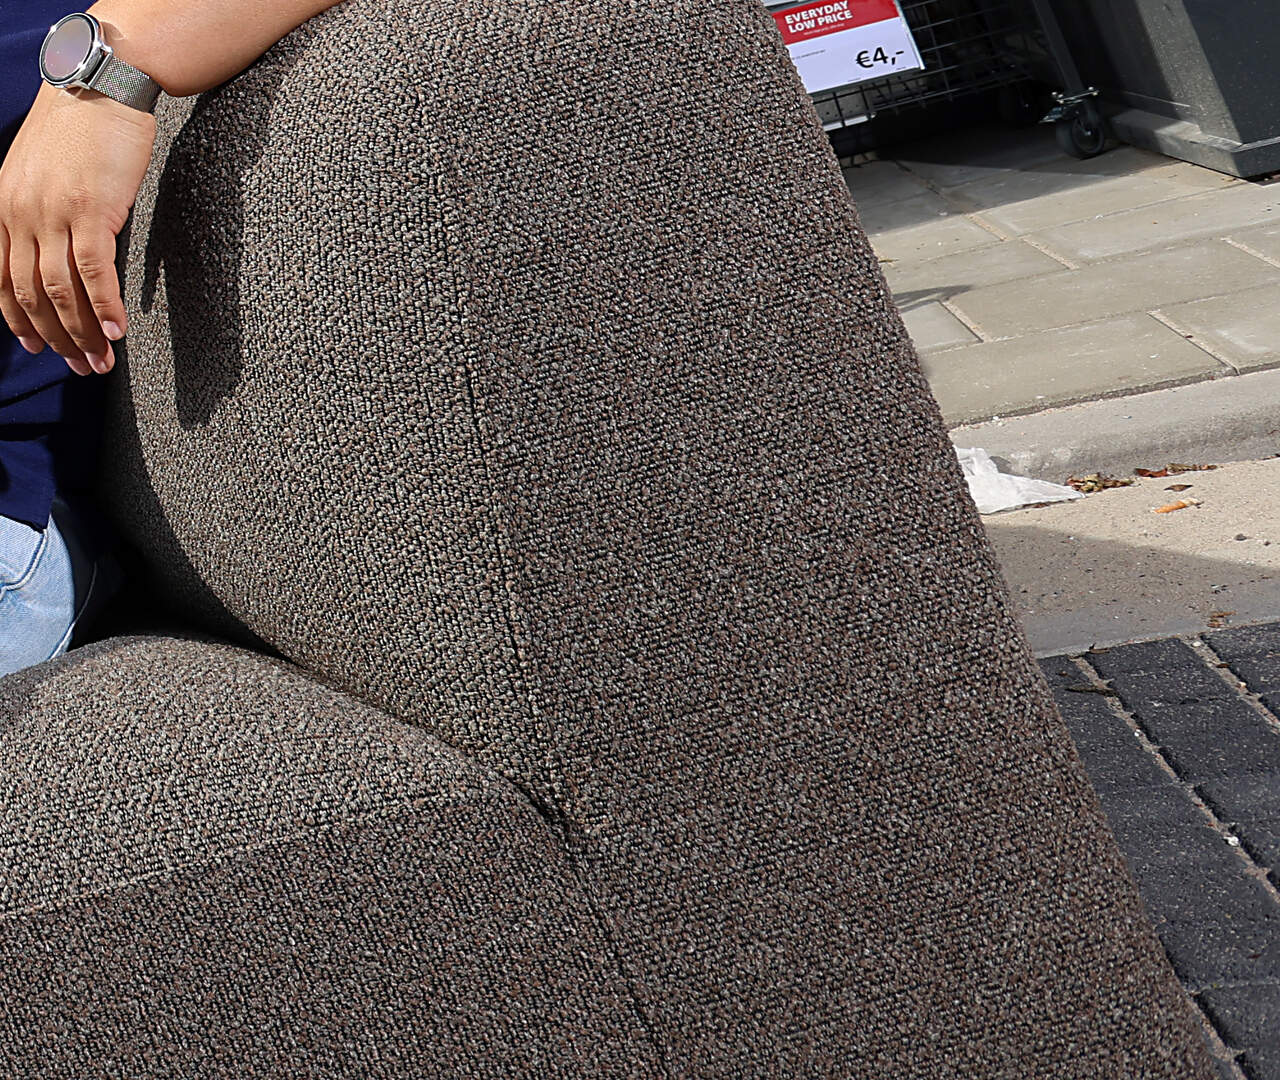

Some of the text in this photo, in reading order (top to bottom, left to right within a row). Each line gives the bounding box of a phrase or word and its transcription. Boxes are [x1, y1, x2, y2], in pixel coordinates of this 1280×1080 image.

[784, 0, 849, 25] EVERYDAY
[788, 20, 816, 34] LOW
[818, 9, 854, 27] PRICE
[855, 46, 905, 69] €4,-
